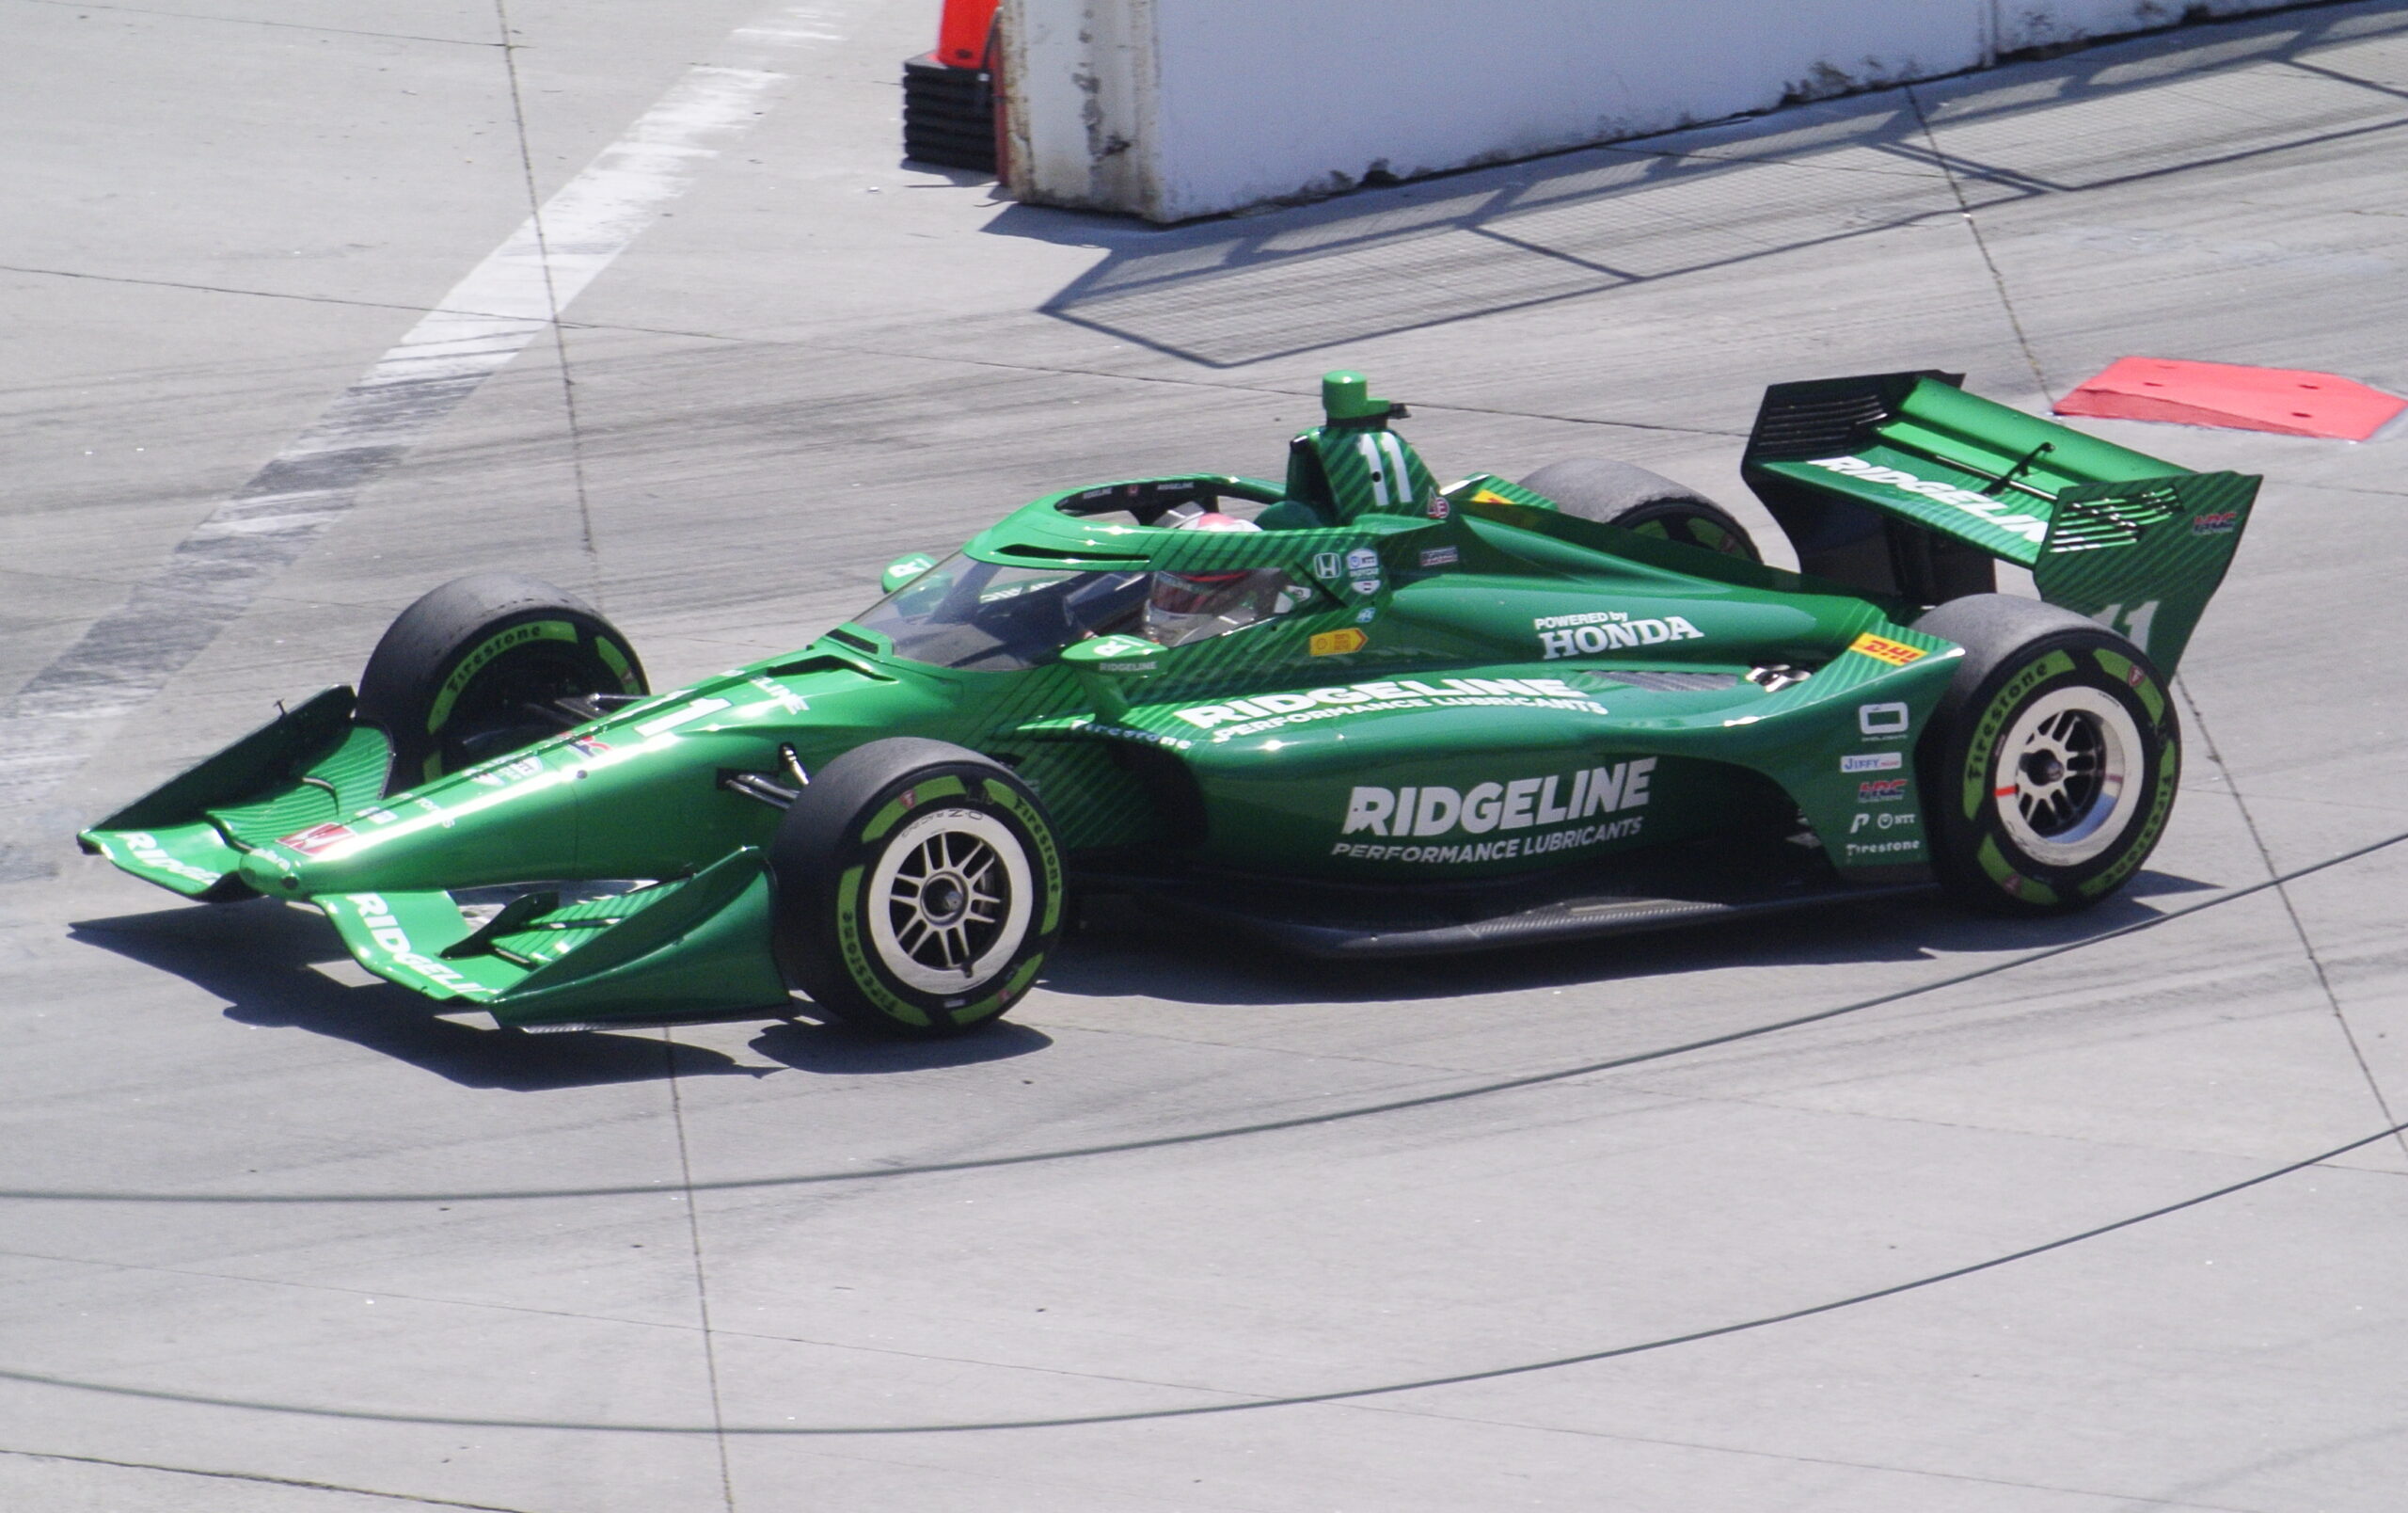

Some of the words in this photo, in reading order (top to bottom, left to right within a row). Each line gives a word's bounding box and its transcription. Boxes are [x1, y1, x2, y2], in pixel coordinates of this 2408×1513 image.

[1357, 432, 1413, 506] 11
[1534, 612, 1608, 629] POWERED
[1609, 612, 1628, 622] by
[1538, 616, 1704, 659] HONDA
[447, 626, 541, 692] Firestone
[1100, 661, 1158, 672] RIDGELINE
[1863, 641, 1921, 662] DHL
[1174, 678, 1591, 729] RIDGELINE
[1212, 698, 1433, 743] PERFORMANCE
[1433, 696, 1608, 715] LUBRICANTS
[1968, 661, 2048, 781] Firestone
[1845, 757, 1879, 771] JIFFY
[1341, 756, 1657, 836] RIDGELINE
[1894, 814, 1915, 824] NTT
[1014, 796, 1060, 894] Firestone
[1330, 838, 1520, 864] PERFORMANCE
[1523, 816, 1643, 854] LUBRICANTS
[1846, 840, 1920, 855] Firestone
